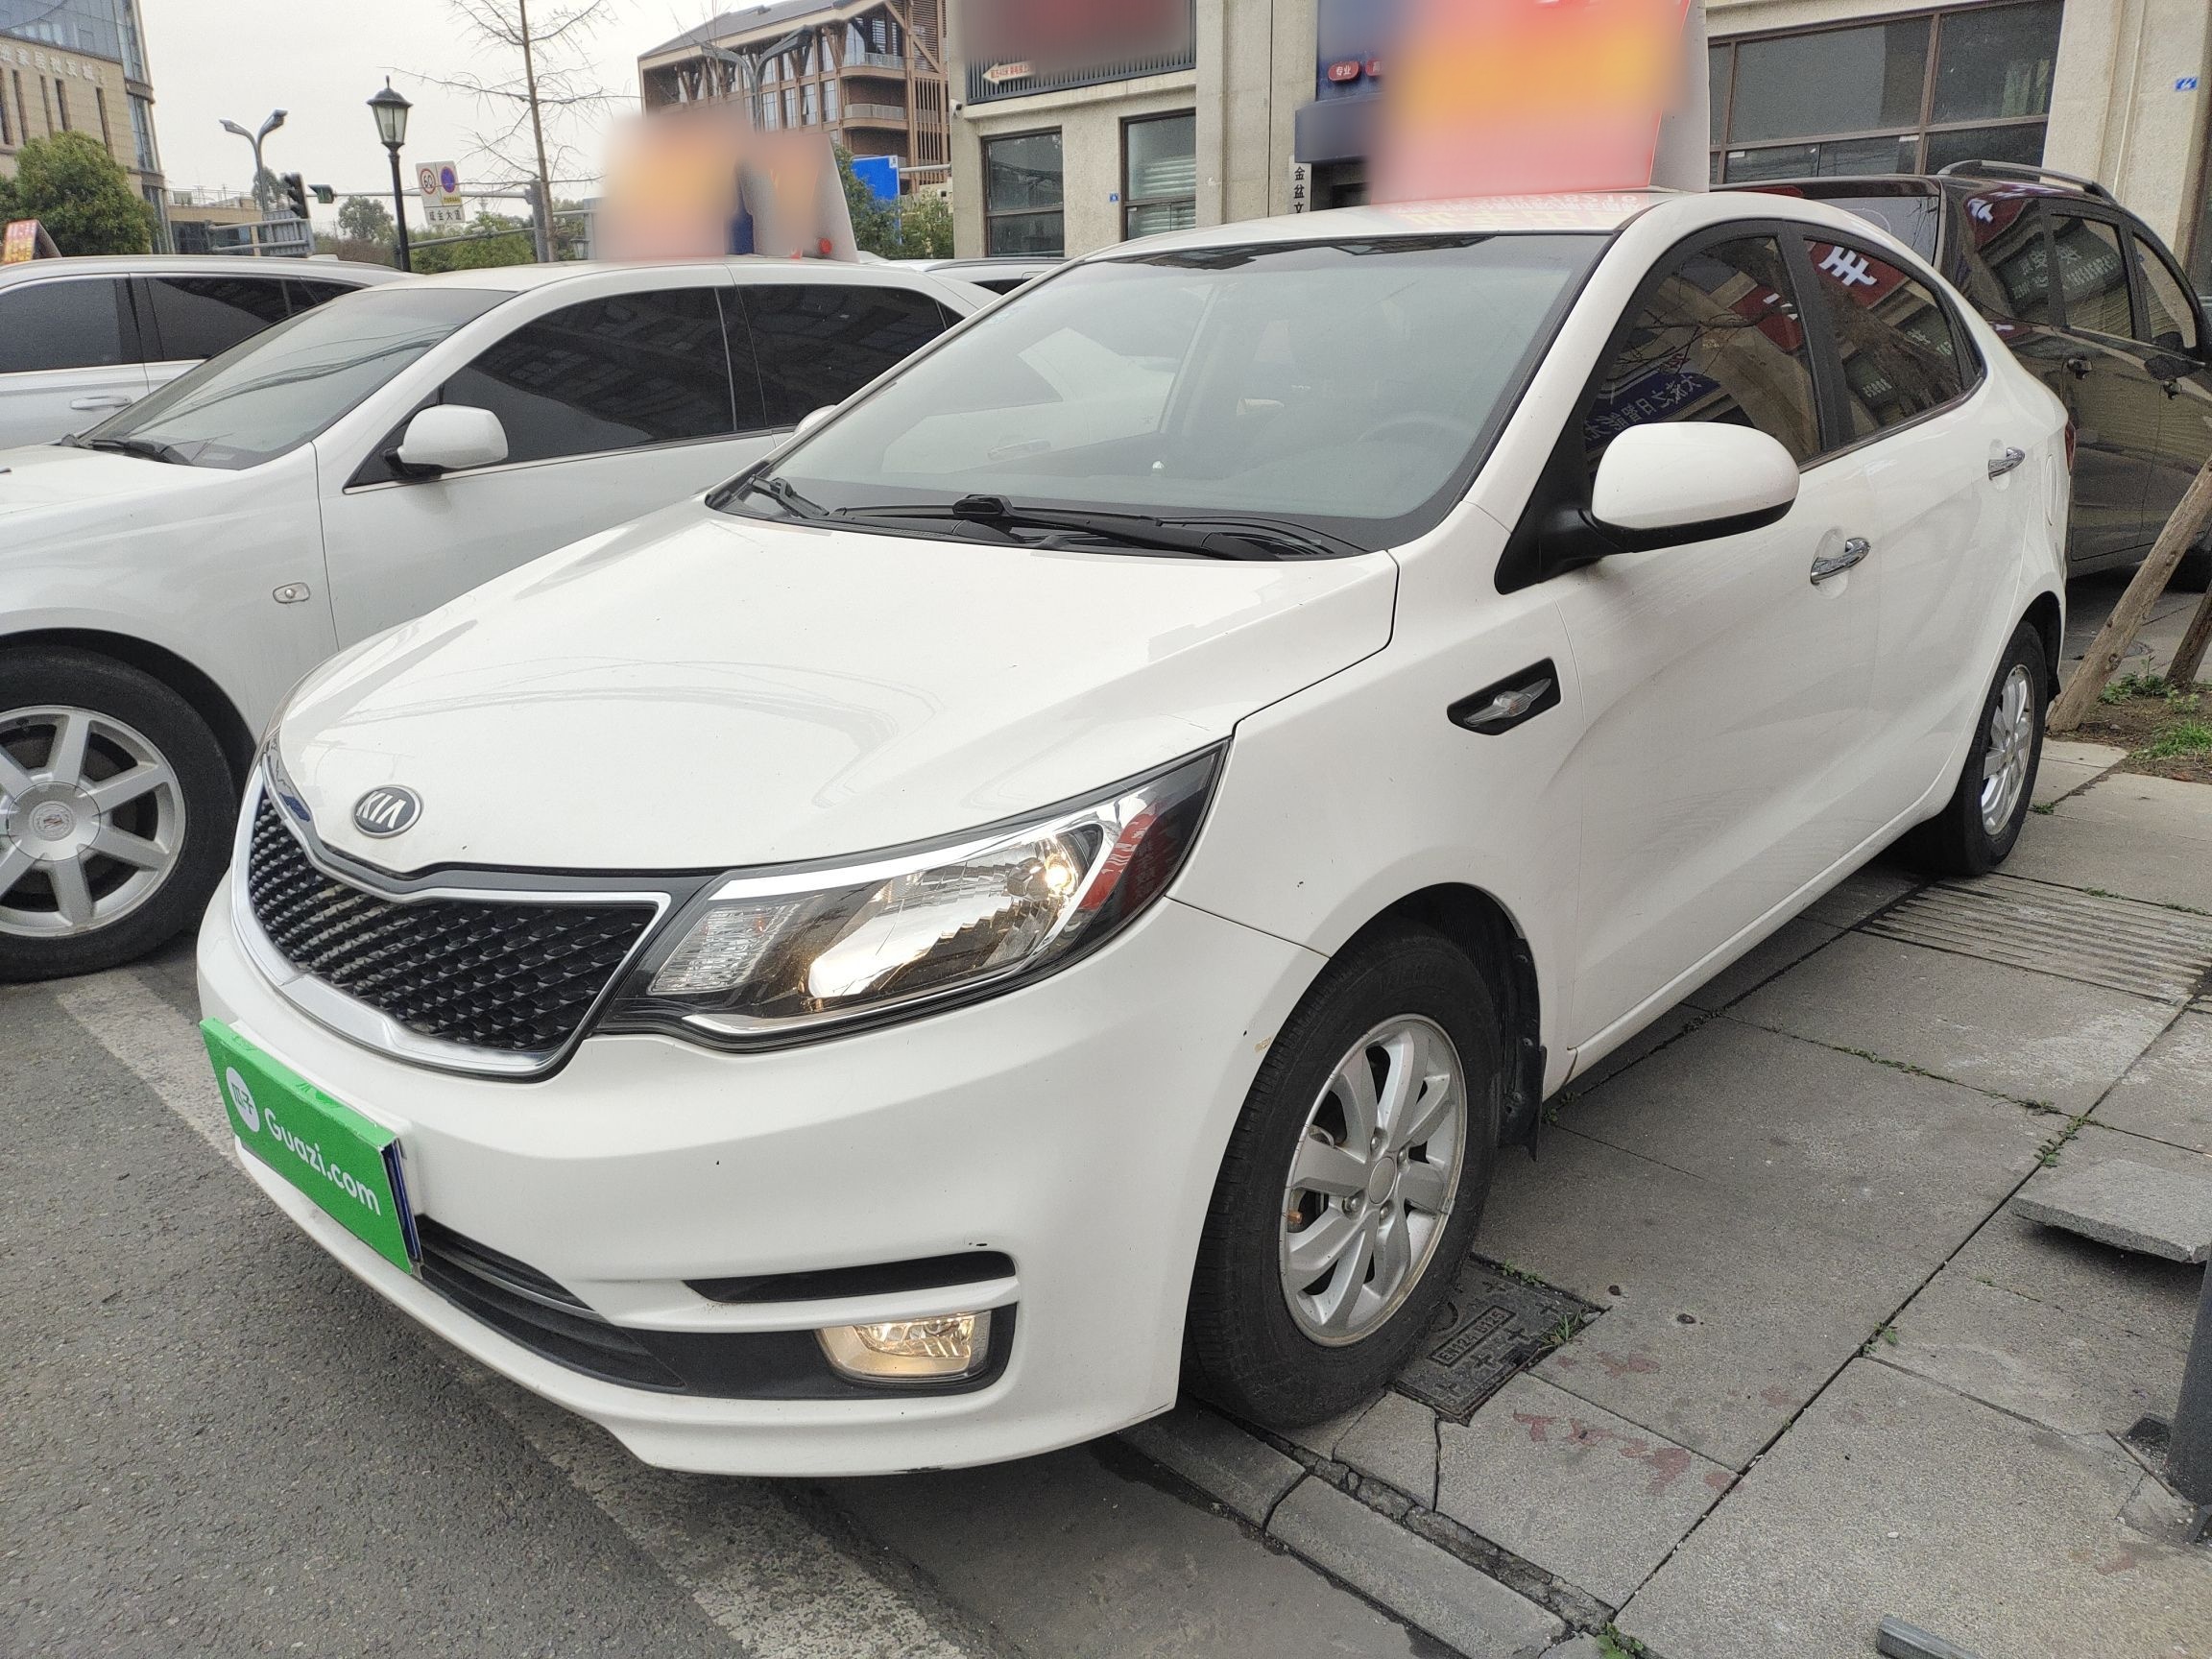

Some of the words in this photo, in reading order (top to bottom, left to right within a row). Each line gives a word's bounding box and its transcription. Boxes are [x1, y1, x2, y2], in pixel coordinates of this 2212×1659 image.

[1335, 64, 1352, 77] 专业
[356, 790, 407, 830] KIA
[264, 1107, 381, 1216] Guazi.com
